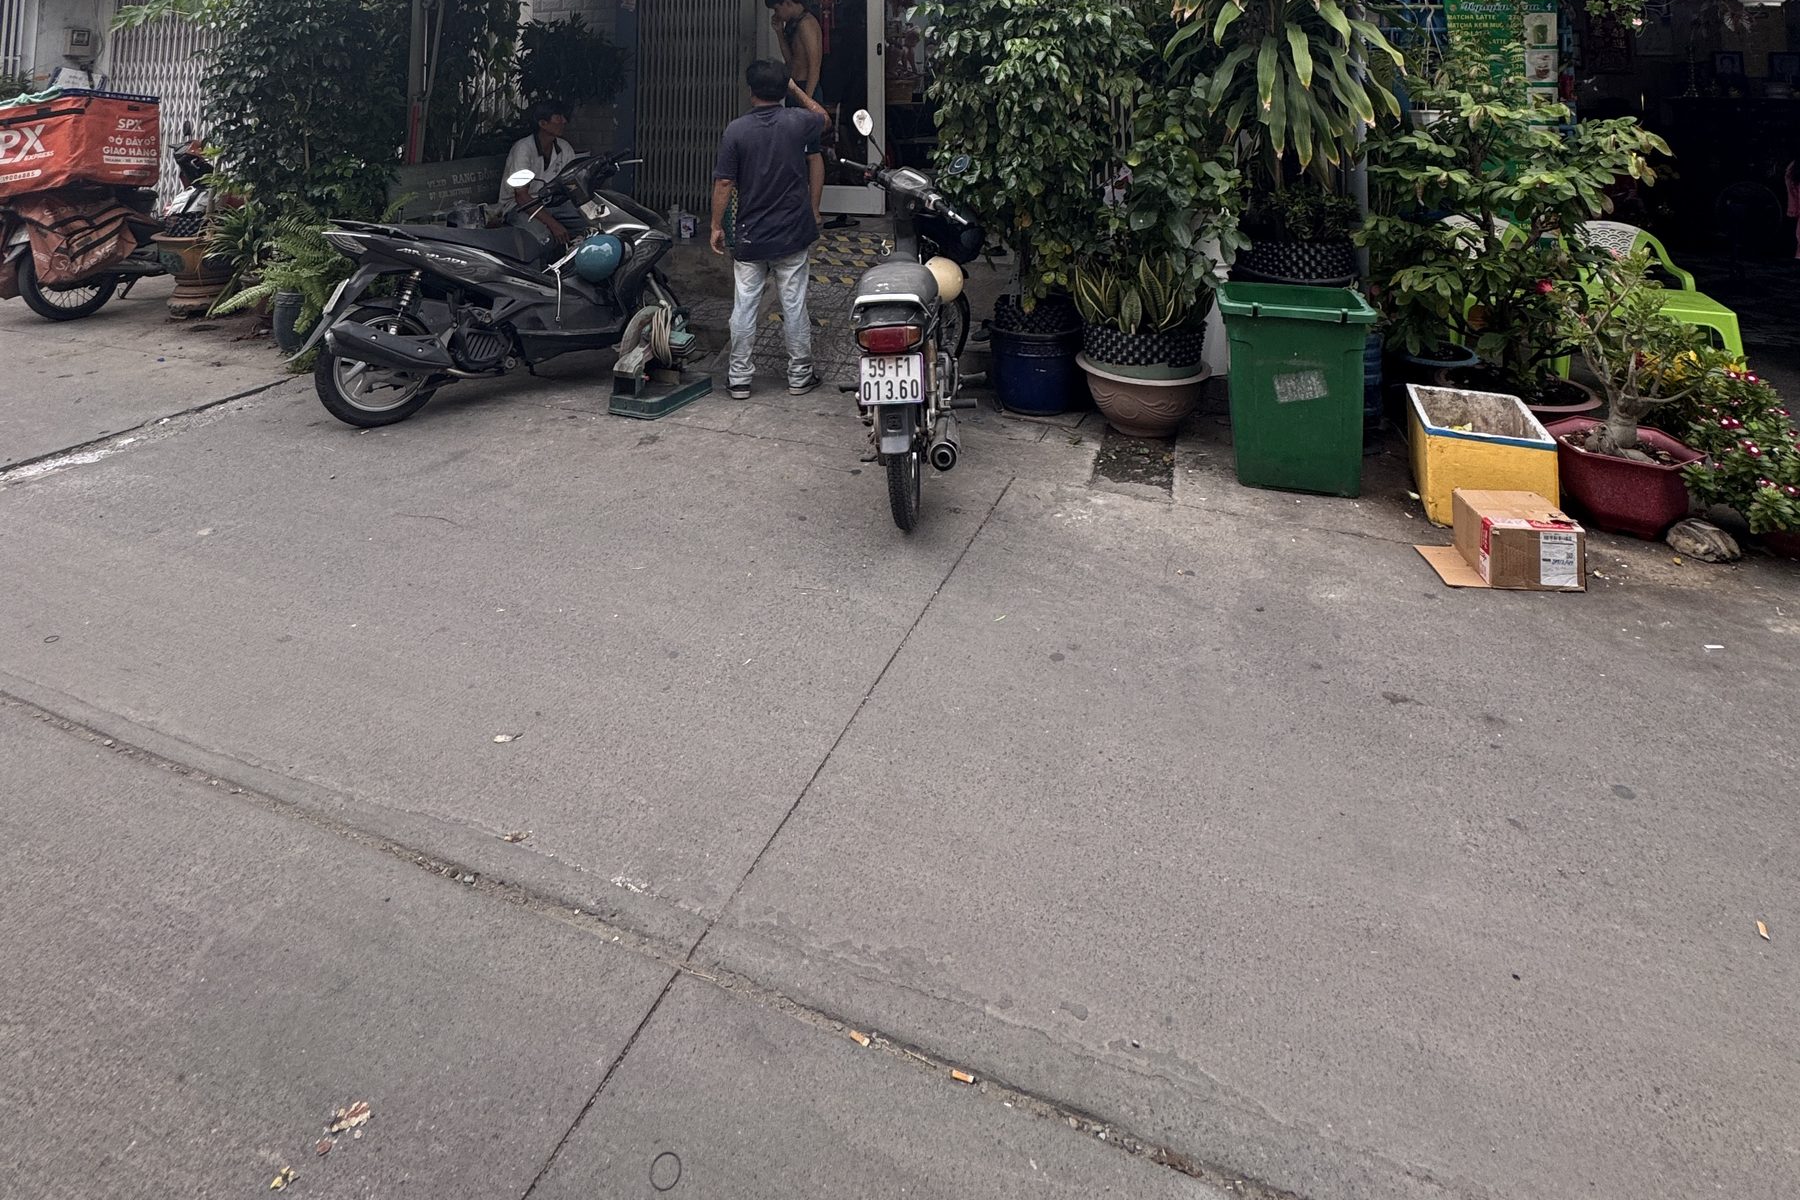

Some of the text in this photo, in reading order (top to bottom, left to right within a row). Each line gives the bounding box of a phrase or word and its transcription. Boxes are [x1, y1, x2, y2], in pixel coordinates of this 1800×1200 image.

[118, 119, 142, 131] SPX
[0, 124, 46, 163] PX
[103, 146, 157, 157] GIAO HÀNG
[868, 356, 911, 378] 59-F1
[863, 379, 919, 401] 013.60
